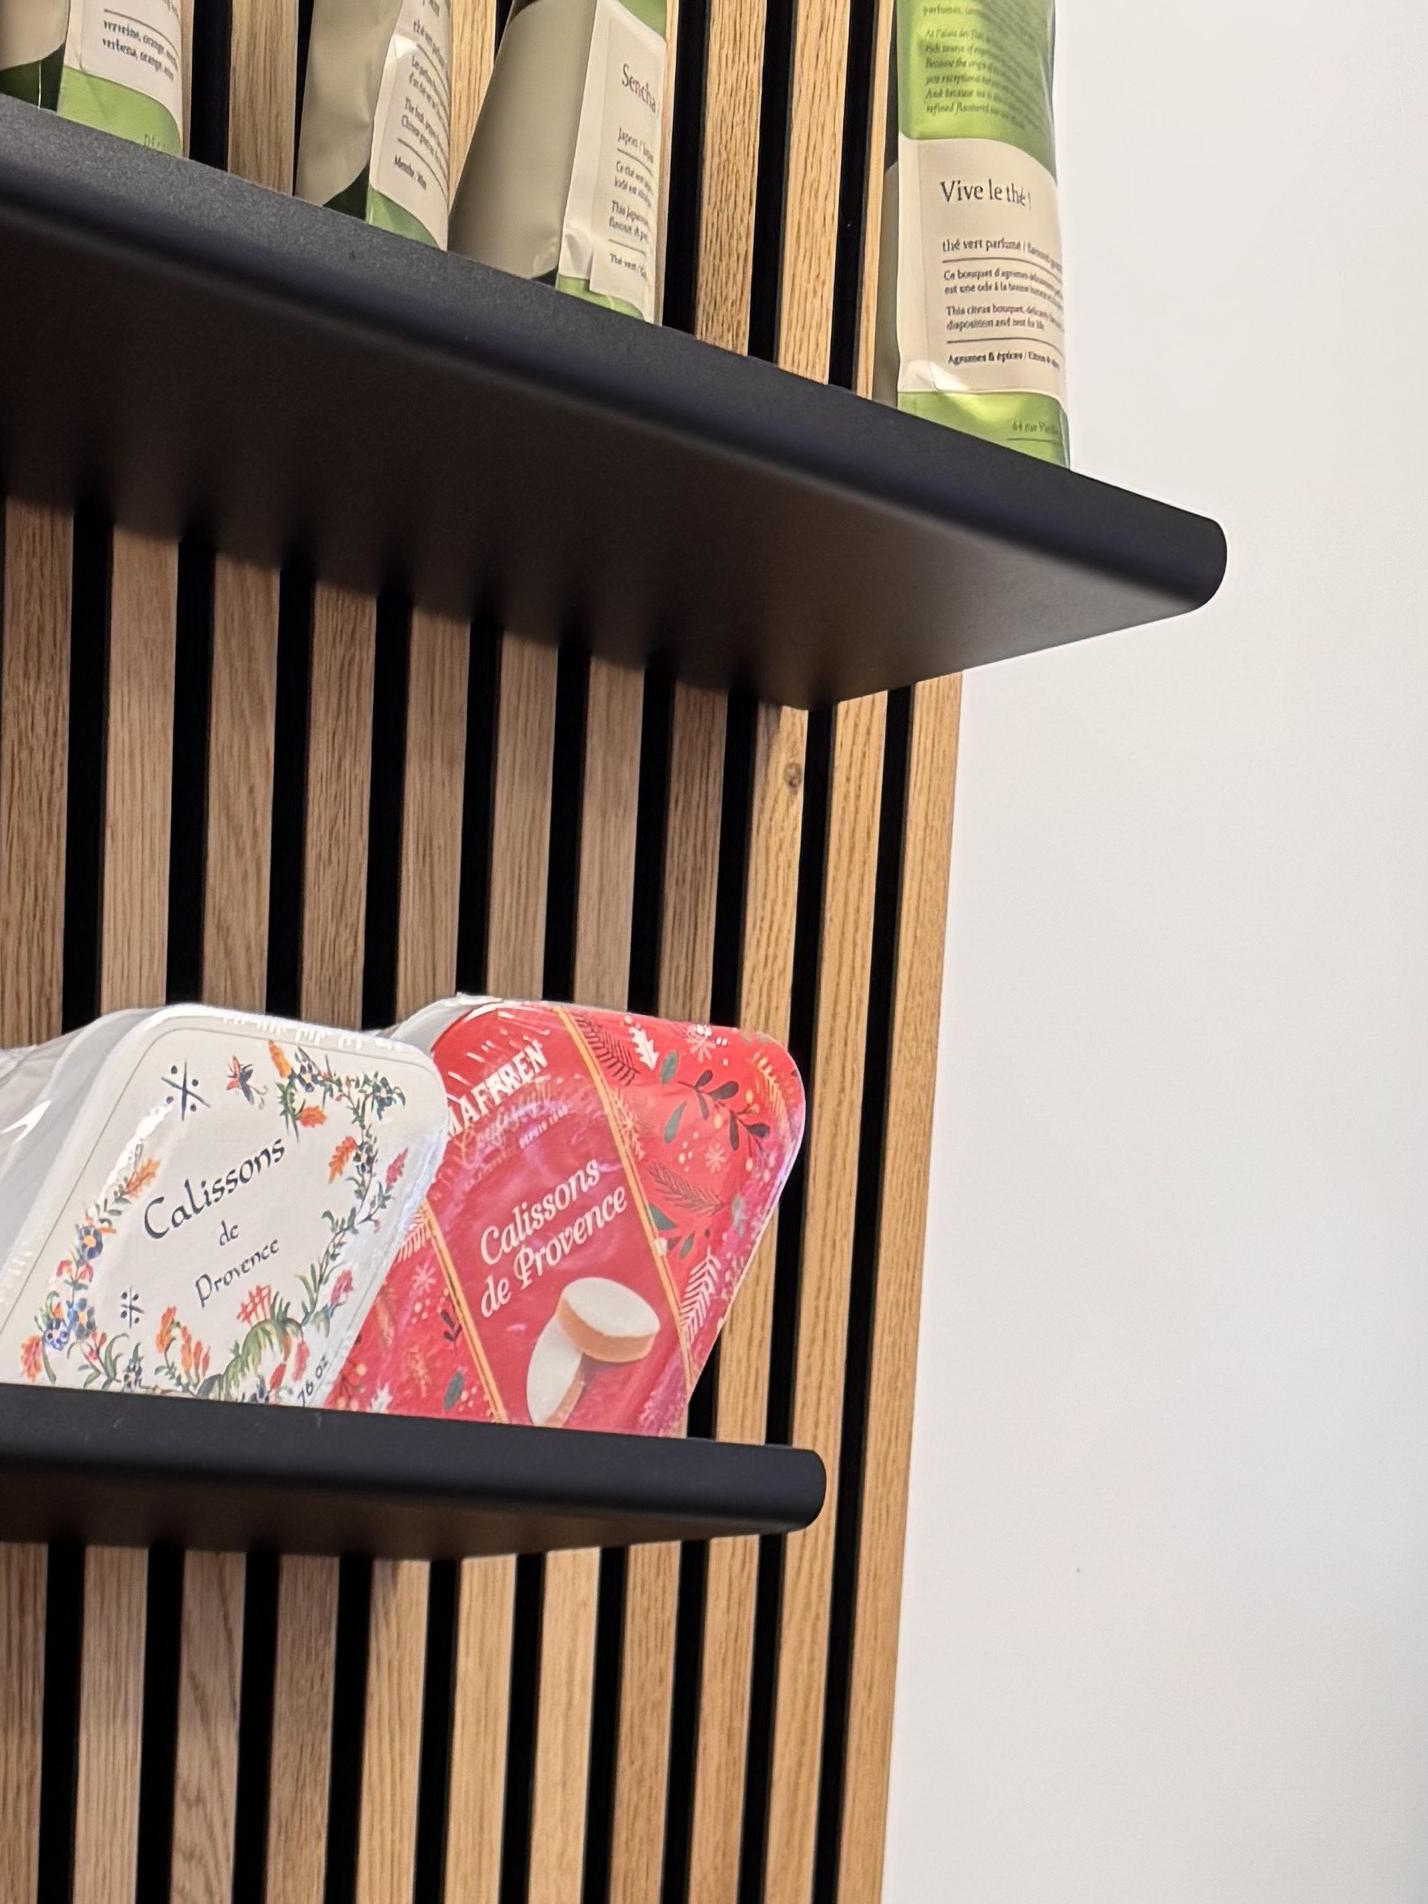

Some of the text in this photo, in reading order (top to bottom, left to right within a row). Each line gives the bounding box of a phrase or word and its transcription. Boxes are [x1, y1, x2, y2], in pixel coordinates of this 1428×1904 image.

[622, 63, 656, 113] Sencha
[940, 179, 983, 203] Vive
[989, 178, 1002, 200] le
[942, 239, 961, 252] thé
[963, 238, 983, 249] vert
[946, 305, 965, 317] This
[948, 353, 987, 367] Agrumes
[144, 1138, 285, 1240] Calissons
[480, 1159, 602, 1265] Calissons
[218, 1220, 240, 1247] de
[480, 1186, 628, 1319] de Provence
[194, 1238, 280, 1309] Provence
